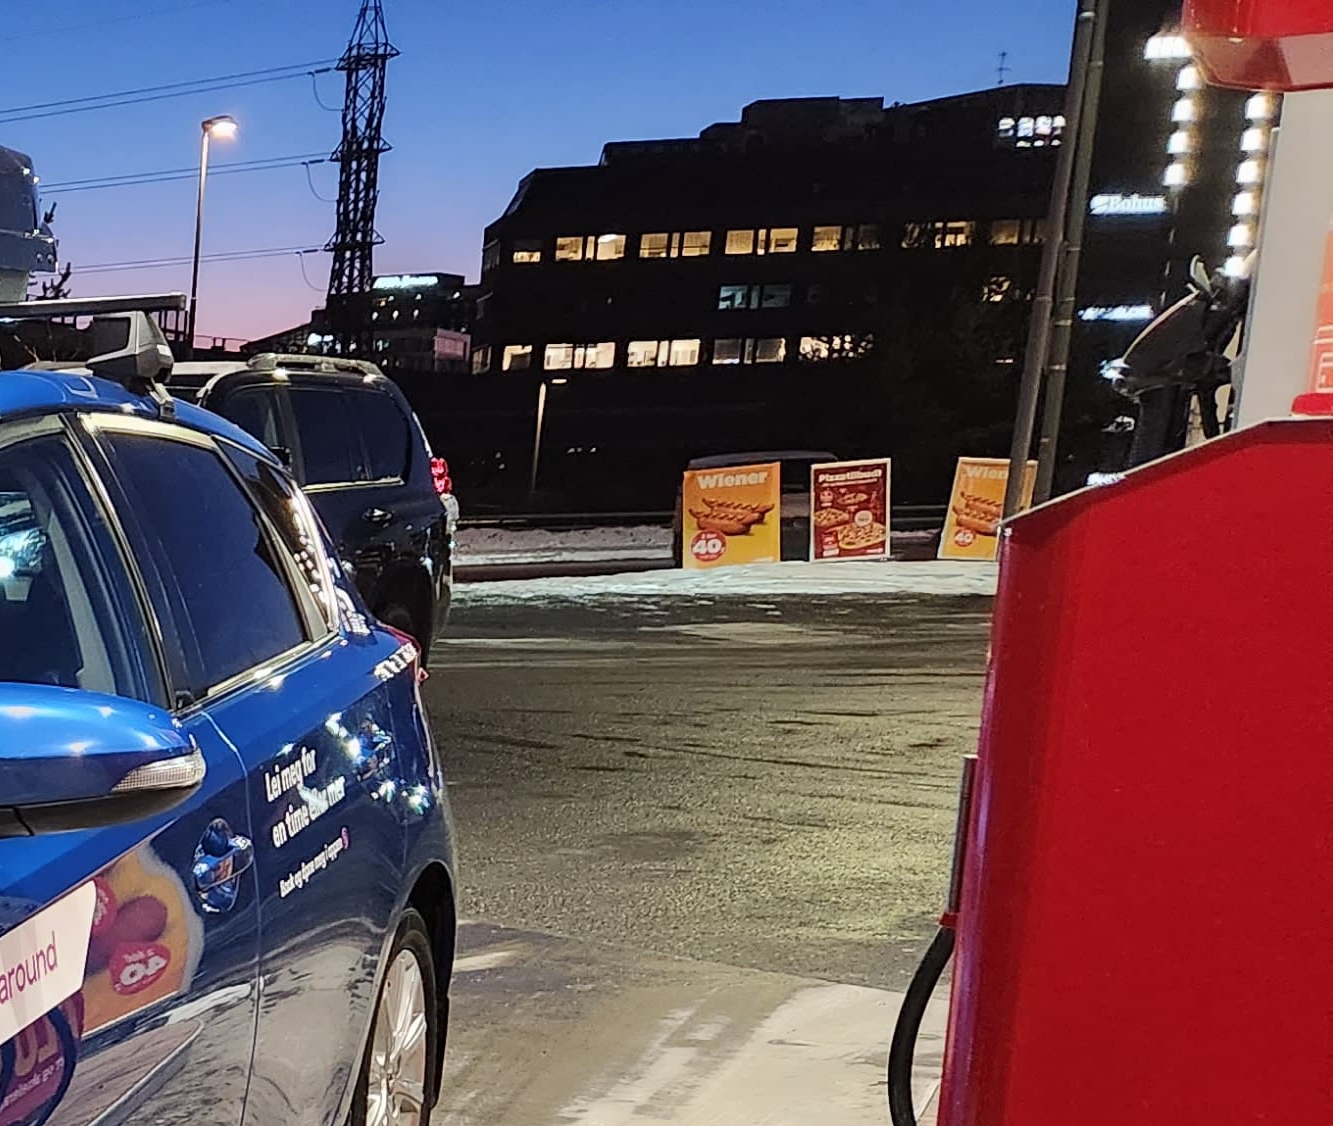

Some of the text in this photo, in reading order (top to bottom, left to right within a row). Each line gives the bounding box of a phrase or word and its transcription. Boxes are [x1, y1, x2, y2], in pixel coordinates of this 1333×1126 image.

[697, 471, 768, 490] Wiener
[265, 746, 316, 803] Lei meg for
[273, 821, 288, 848] en
[285, 804, 310, 838] time
